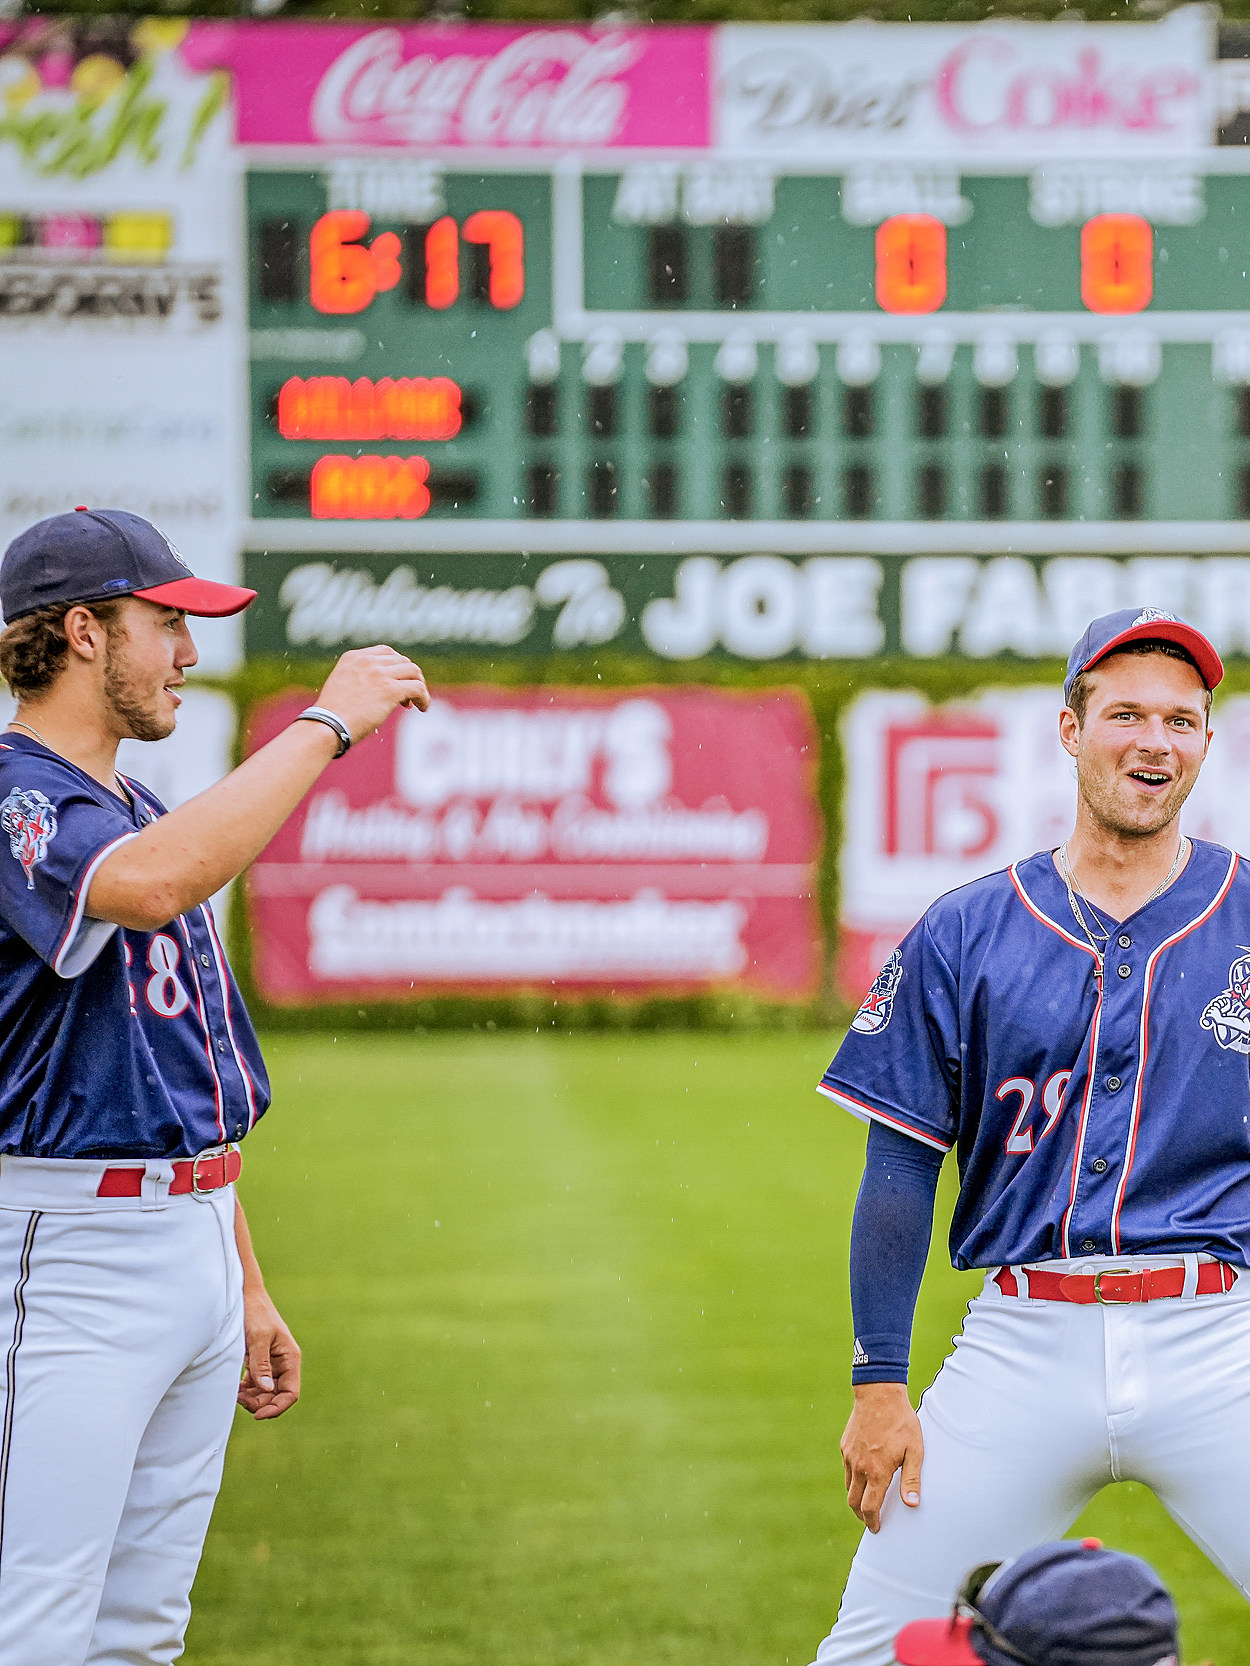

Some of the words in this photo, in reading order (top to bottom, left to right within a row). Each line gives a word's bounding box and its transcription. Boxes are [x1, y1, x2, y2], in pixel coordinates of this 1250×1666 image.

[936, 36, 1203, 136] Coke
[309, 210, 524, 314] 6:17
[875, 212, 948, 315] 0
[1081, 212, 1153, 315] 0
[280, 562, 534, 647] Welcome
[535, 558, 627, 648] To
[642, 554, 887, 660] JOE
[995, 1069, 1073, 1155] 29
